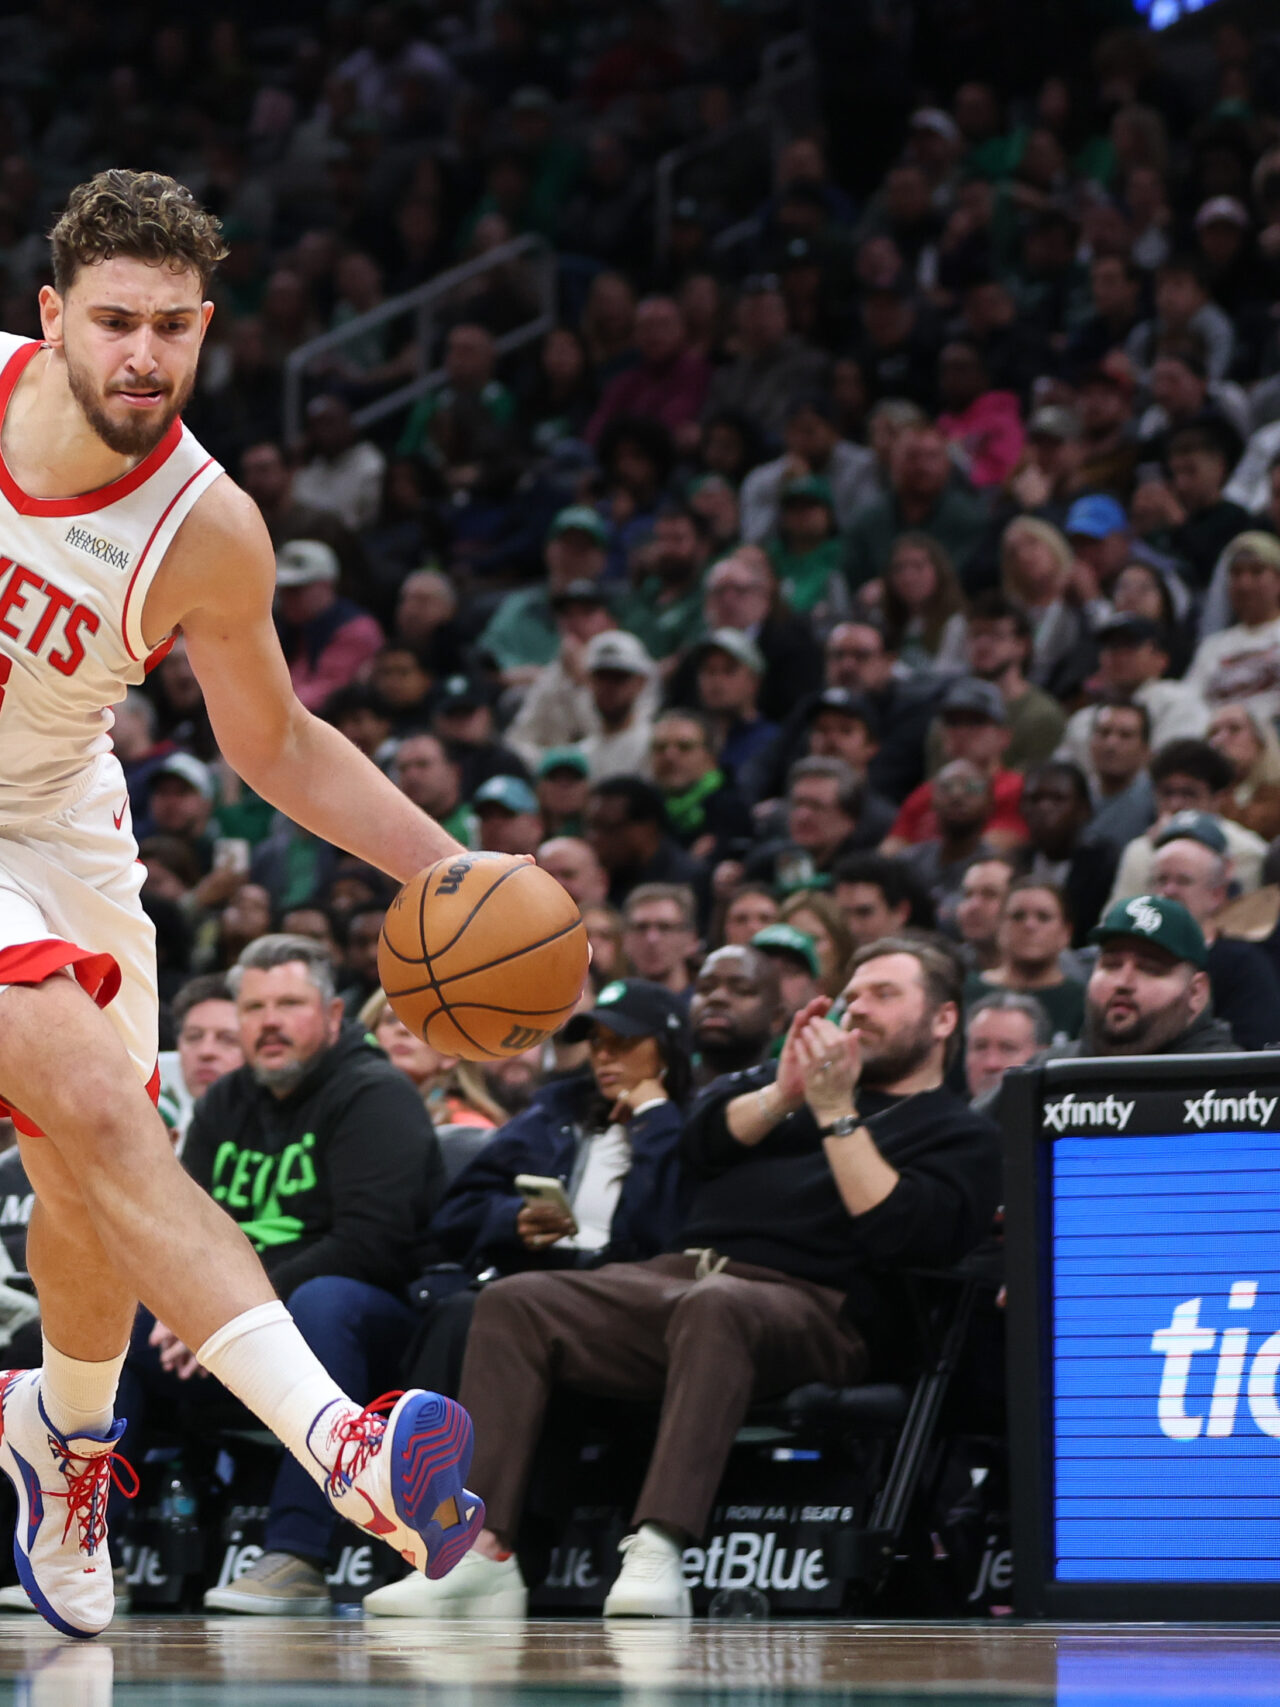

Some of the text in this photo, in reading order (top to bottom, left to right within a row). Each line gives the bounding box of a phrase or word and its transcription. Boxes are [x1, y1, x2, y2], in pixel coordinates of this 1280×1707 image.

[65, 534, 129, 571] HERMANN
[67, 525, 130, 562] MEMORIAL
[1043, 1093, 1136, 1132] xfinity
[1183, 1089, 1279, 1128] xfinity
[799, 1505, 841, 1522] SEAT
